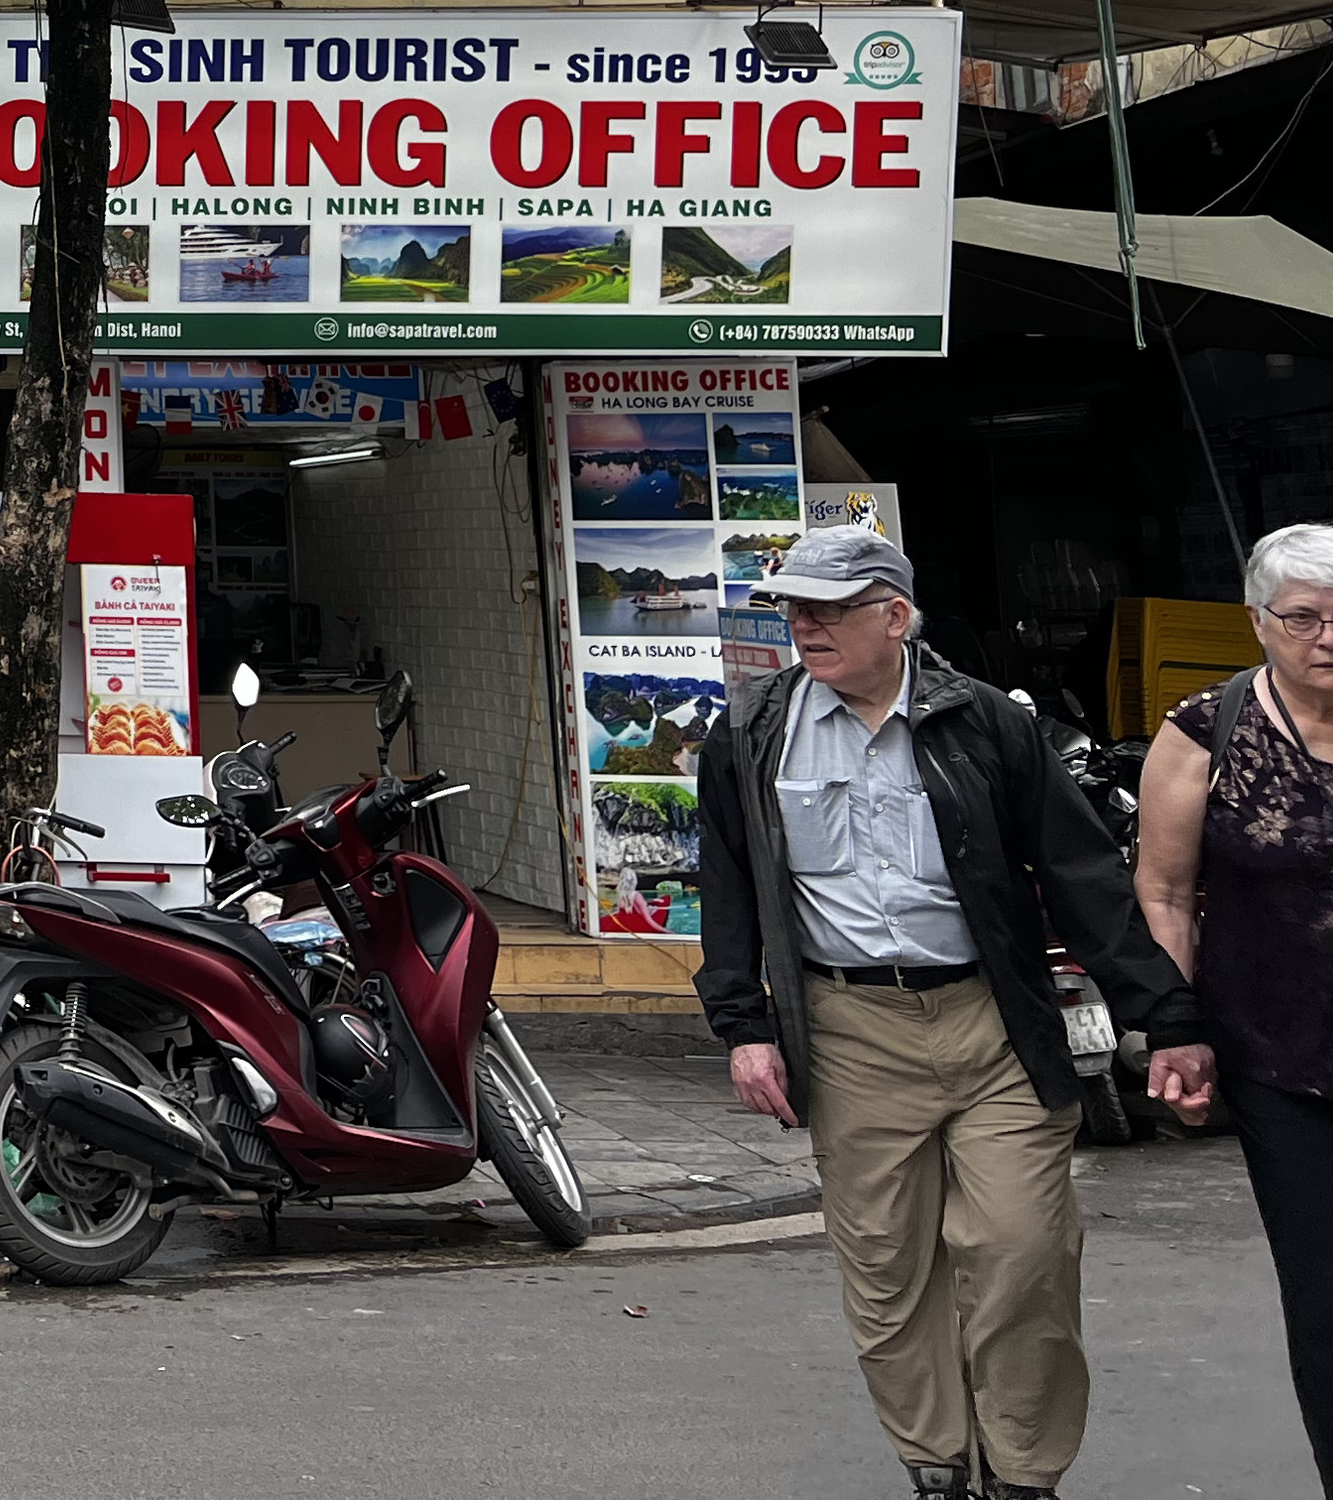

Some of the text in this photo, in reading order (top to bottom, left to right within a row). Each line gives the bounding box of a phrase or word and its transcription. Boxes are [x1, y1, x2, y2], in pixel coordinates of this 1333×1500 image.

[129, 38, 264, 84] SINH
[284, 37, 519, 84] TOURIST
[566, 47, 691, 84] since
[863, 60, 905, 70] tripadvisor
[489, 98, 923, 189] OFFICE
[171, 197, 773, 219] HALONG NINH BINH SAPA HA GIANG
[3, 321, 24, 341] St,
[107, 322, 138, 341] Dist,
[141, 322, 182, 339] Hanoi
[347, 322, 498, 342] info@sapatravel.com
[719, 323, 915, 343] (+84) 787590333 WhatsApp
[564, 368, 790, 393] BOOKING OFFICE
[601, 398, 623, 410] HA
[626, 397, 669, 410] LONG
[672, 396, 701, 409] BAY
[704, 395, 755, 408] CRUISE
[805, 499, 843, 521] iger
[139, 602, 176, 612] TAIYAKI
[588, 645, 696, 658] CAT BA ISLAND
